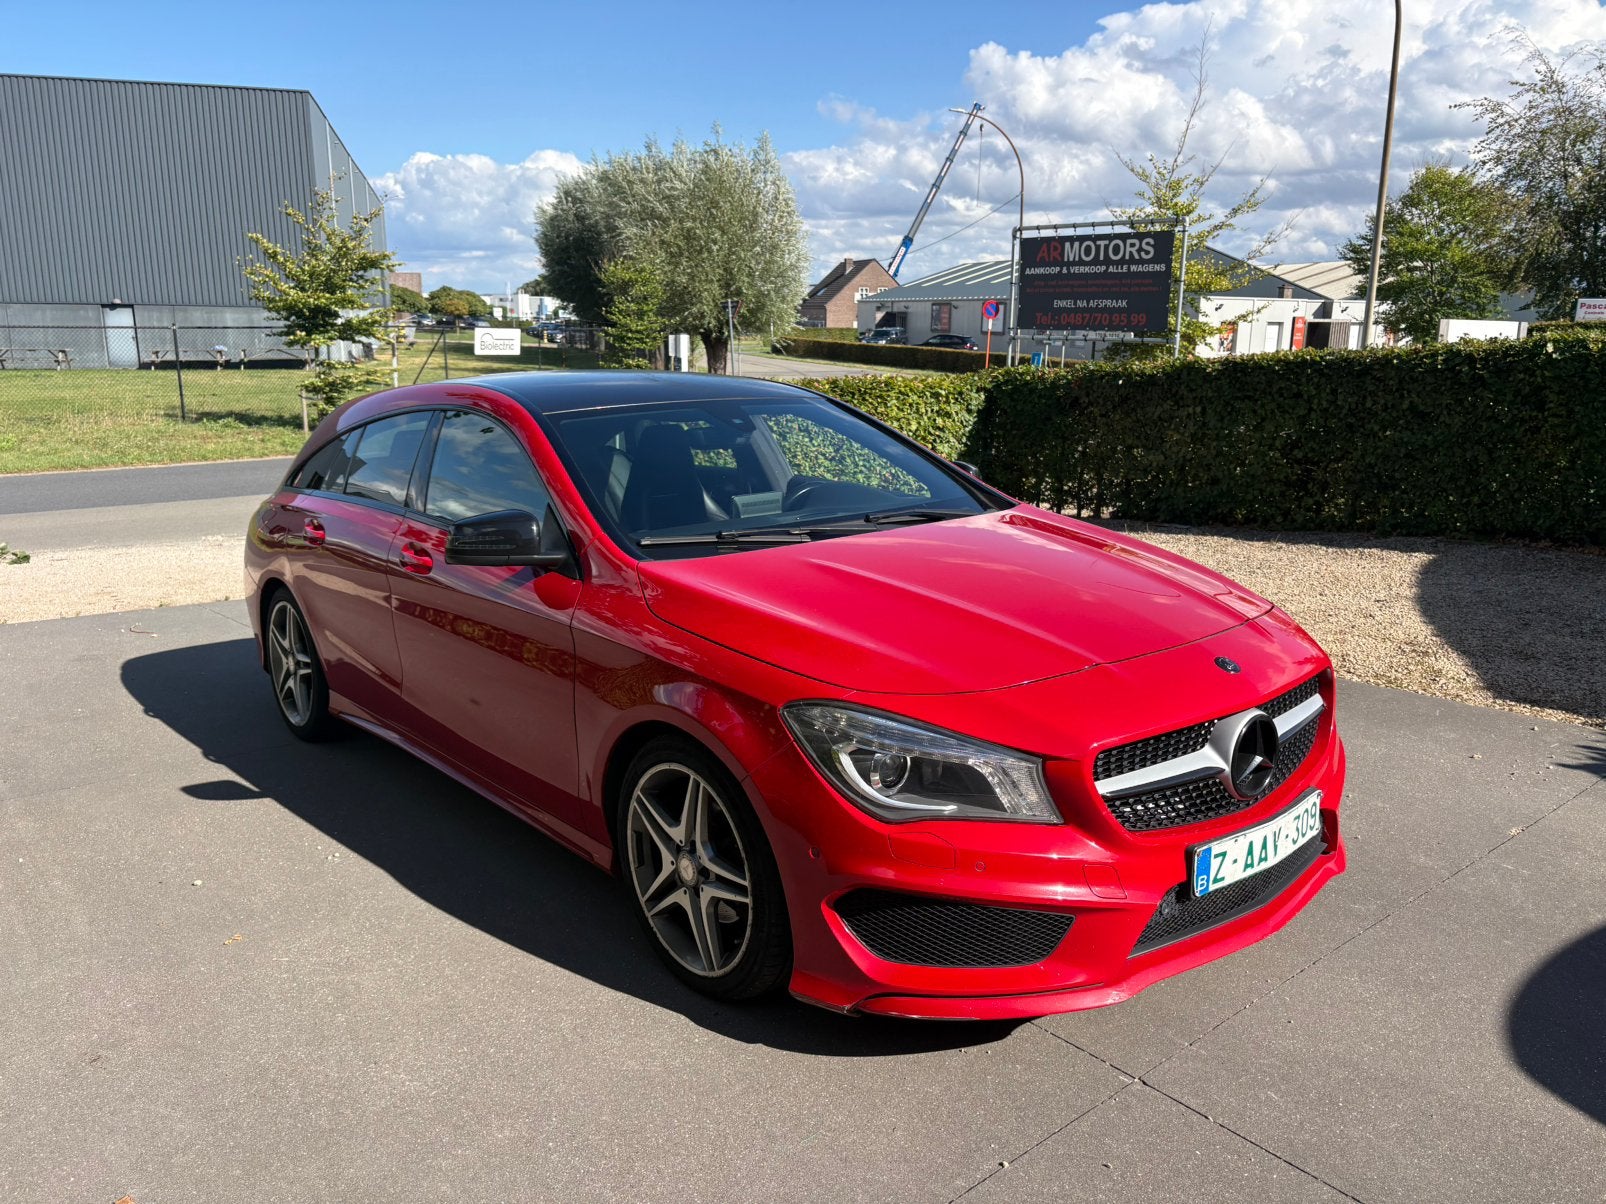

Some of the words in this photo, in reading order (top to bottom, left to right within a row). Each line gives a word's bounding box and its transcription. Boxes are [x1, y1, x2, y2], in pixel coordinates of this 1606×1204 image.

[1036, 240, 1062, 262] AR
[1063, 238, 1155, 262] MOTORS
[1025, 266, 1061, 275] AANKOOP
[1062, 266, 1068, 274] &
[1069, 265, 1107, 274] VERKOOP
[1108, 264, 1128, 273] ALLE
[1130, 263, 1166, 272] WAGENS
[1053, 299, 1076, 308] ENKEL
[1076, 299, 1087, 308] NA
[1088, 299, 1128, 308] AFSPRAAK
[1061, 312, 1110, 326] 0487/70
[1112, 313, 1127, 325] 95
[1130, 312, 1147, 325] 99
[480, 340, 515, 351] Biolectric
[1197, 875, 1208, 890] B
